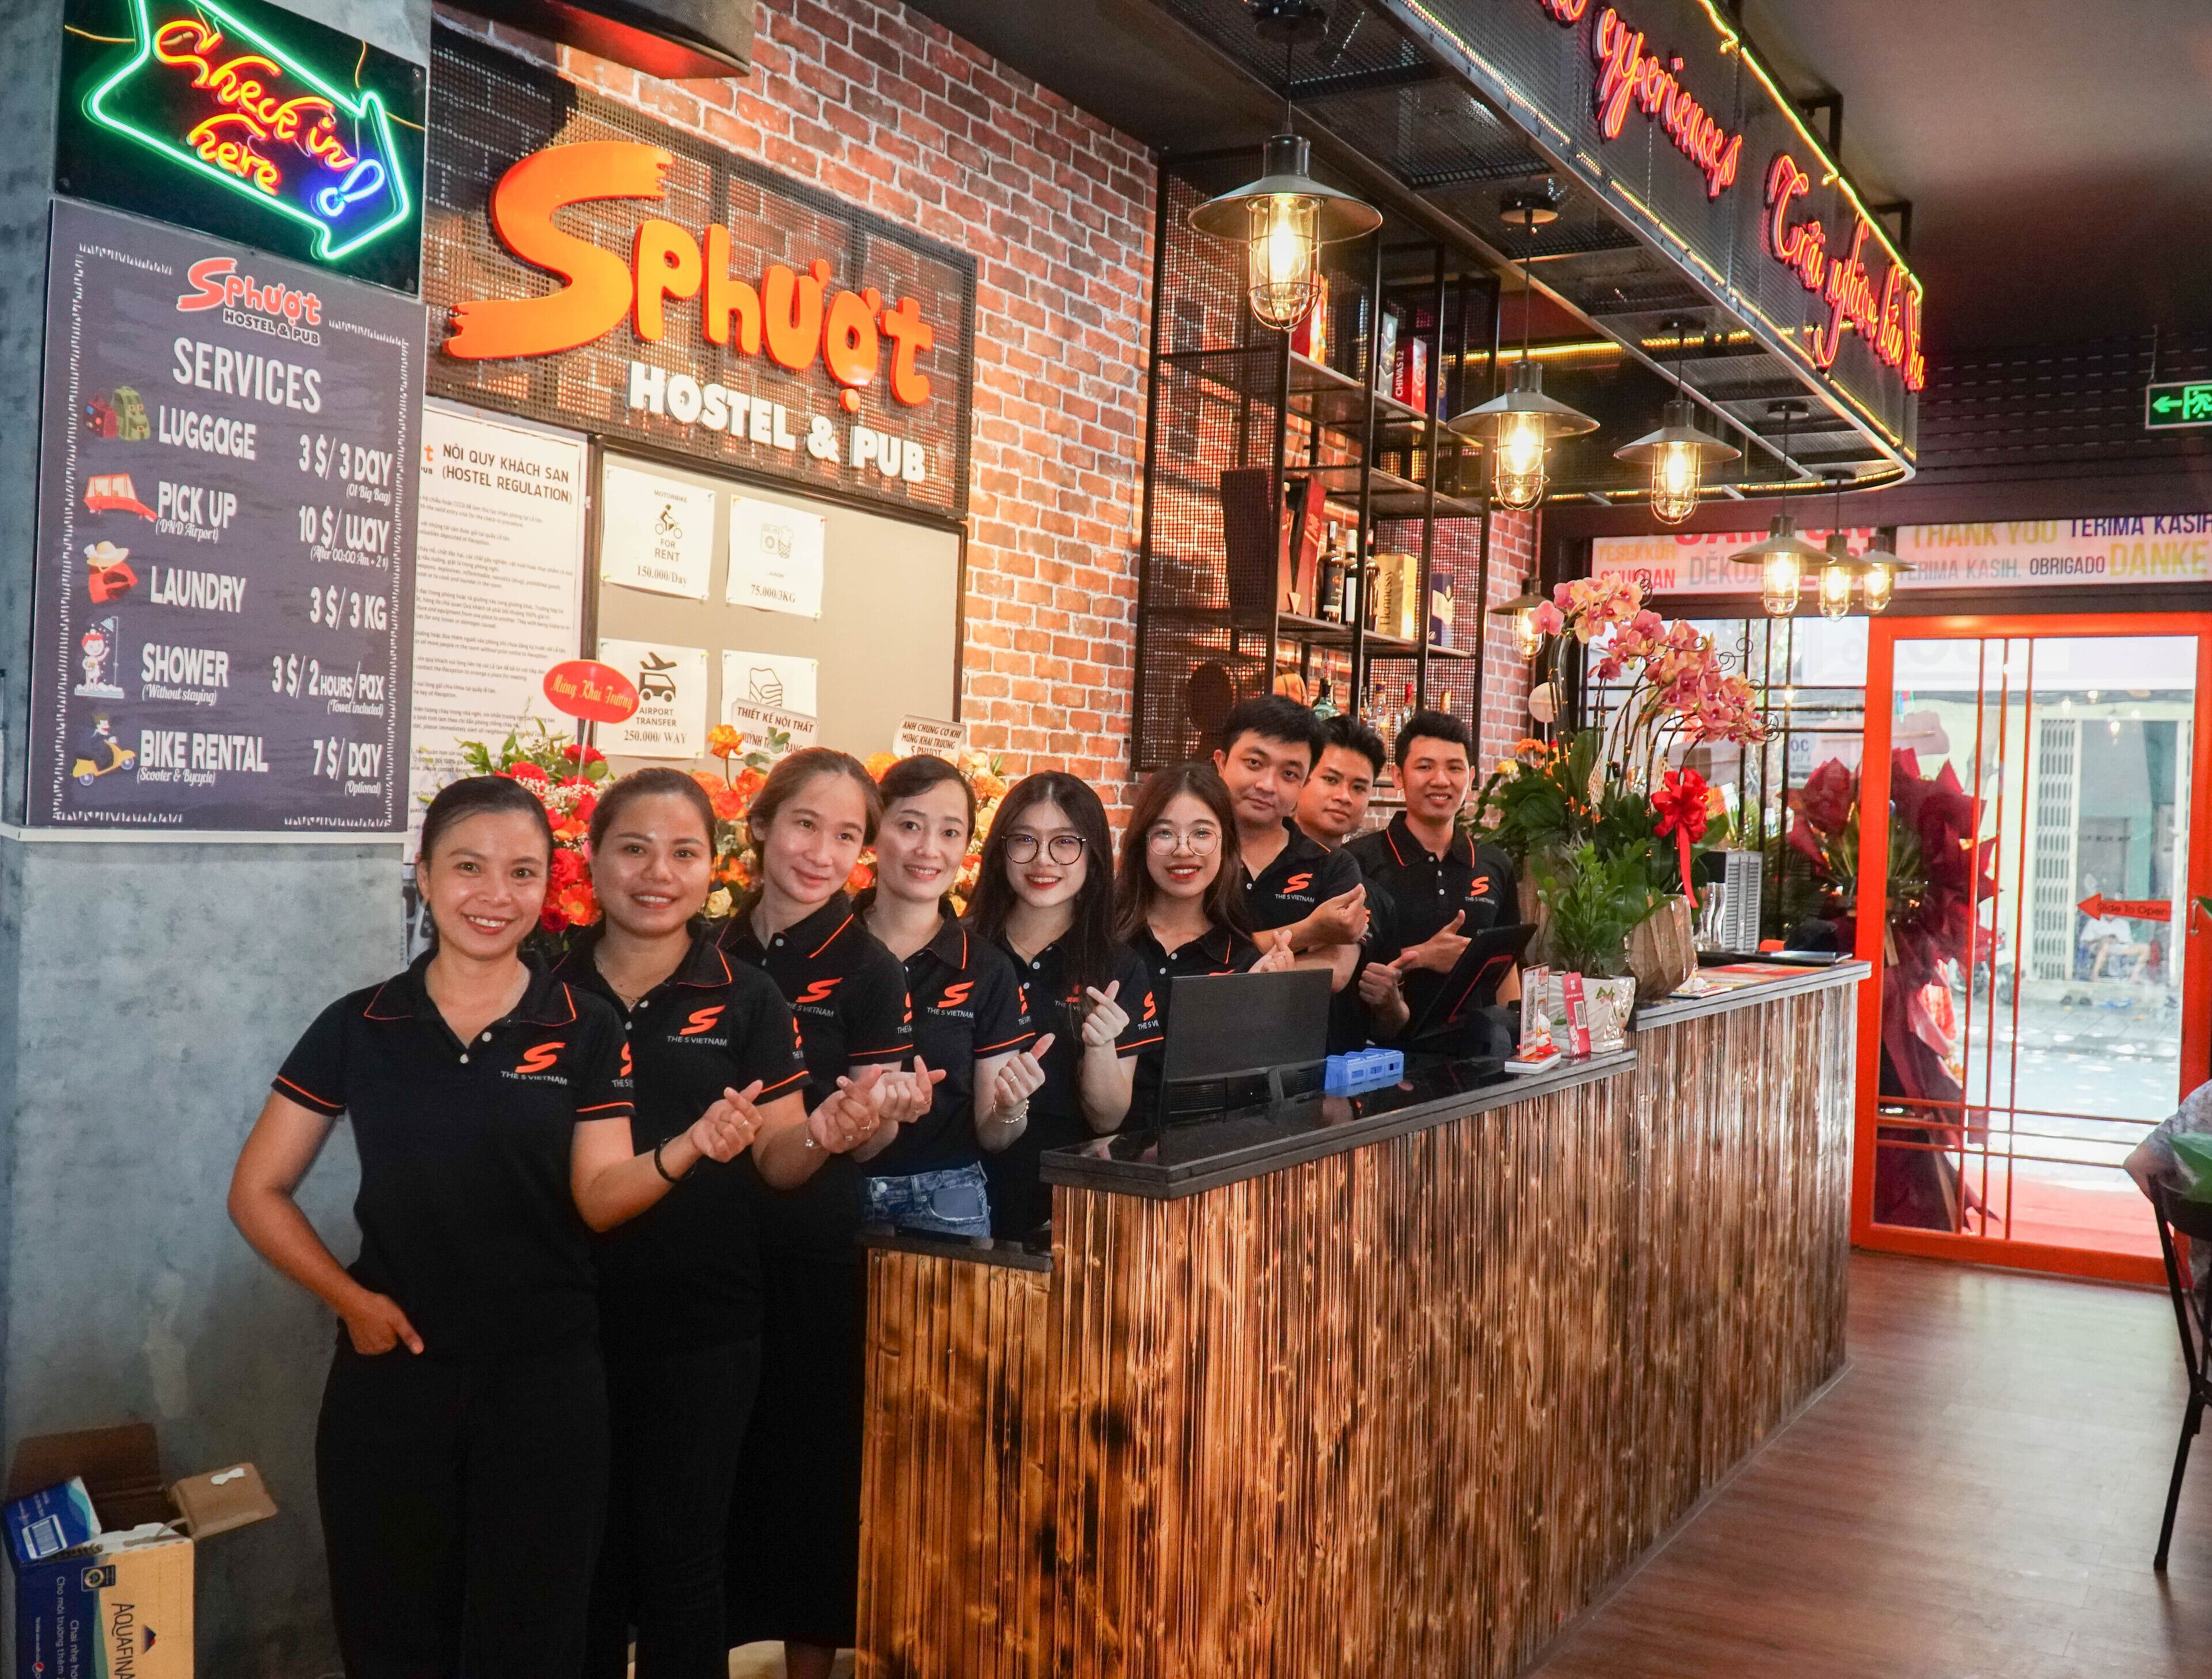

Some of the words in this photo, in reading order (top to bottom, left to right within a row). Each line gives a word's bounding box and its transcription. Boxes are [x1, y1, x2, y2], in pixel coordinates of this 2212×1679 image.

[152, 19, 335, 139] Check
[306, 117, 358, 170] in
[1594, 8, 1743, 196] experiences
[186, 113, 282, 195] here
[445, 140, 934, 412] Sphượt
[176, 257, 321, 326] Sphượt
[223, 308, 276, 335] HOSTEL
[277, 323, 290, 339] &
[292, 327, 320, 345] PUB
[173, 338, 321, 413] SERVICES
[1395, 361, 1404, 397] CHIVAS
[627, 361, 796, 451] HOSTEL
[806, 415, 840, 463] &
[850, 425, 926, 483] PUB
[159, 405, 257, 460] LUGGAGE
[299, 434, 310, 471] 3
[339, 443, 350, 479] 3
[354, 446, 392, 486] DAY
[443, 443, 464, 463] NỘI
[469, 450, 495, 467] QUY
[500, 456, 540, 477] KHÁCH
[359, 485, 373, 503] Big
[442, 465, 491, 487] (HOSTEL
[498, 476, 572, 505] REGULATION)
[654, 490, 688, 503] MOTORBIKE
[158, 481, 203, 525] PICK
[209, 490, 237, 528] UP
[184, 521, 218, 544] Airport)
[299, 506, 316, 543] 10
[346, 514, 391, 554] WAY
[1912, 521, 1996, 548] THANK
[2071, 517, 2144, 537] TERIMA
[654, 548, 680, 562] RENT
[660, 539, 676, 548] FOR
[1899, 559, 1958, 582] ERIMA
[2029, 556, 2105, 577] OBRIGADO
[2109, 540, 2209, 577] DANKE
[150, 566, 246, 612] LAUNDRY
[310, 587, 321, 623] 3
[349, 592, 360, 628] 3
[365, 595, 387, 631] KG
[751, 584, 797, 603] 75.000/3KG
[1380, 571, 1392, 626] Hennessy
[141, 642, 229, 687] SHOWER
[272, 655, 283, 692] 3
[309, 660, 319, 695] 2
[142, 684, 181, 701] (Without
[182, 688, 217, 706] staying)
[636, 717, 677, 726] TRANSFER
[639, 707, 673, 717] AIRPORT
[664, 733, 686, 744] WAY
[140, 730, 187, 768] BIKE
[192, 733, 269, 772] RENTAL
[313, 740, 323, 775] 7
[348, 742, 382, 777] DAY
[137, 767, 172, 784] (Scooter
[173, 768, 181, 782] &
[344, 780, 381, 798] (Optional)
[1291, 895, 1315, 903] VIETNAM
[803, 1005, 834, 1018] VIETNAM
[927, 1007, 940, 1015] THE
[947, 1010, 974, 1019] VIETNAM
[1137, 1023, 1147, 1031] THE
[691, 1037, 728, 1047] VIETNAM
[501, 1071, 518, 1079] THE
[528, 1075, 567, 1086] VIETNAM
[111, 1603, 136, 1679] AQUAFINA
